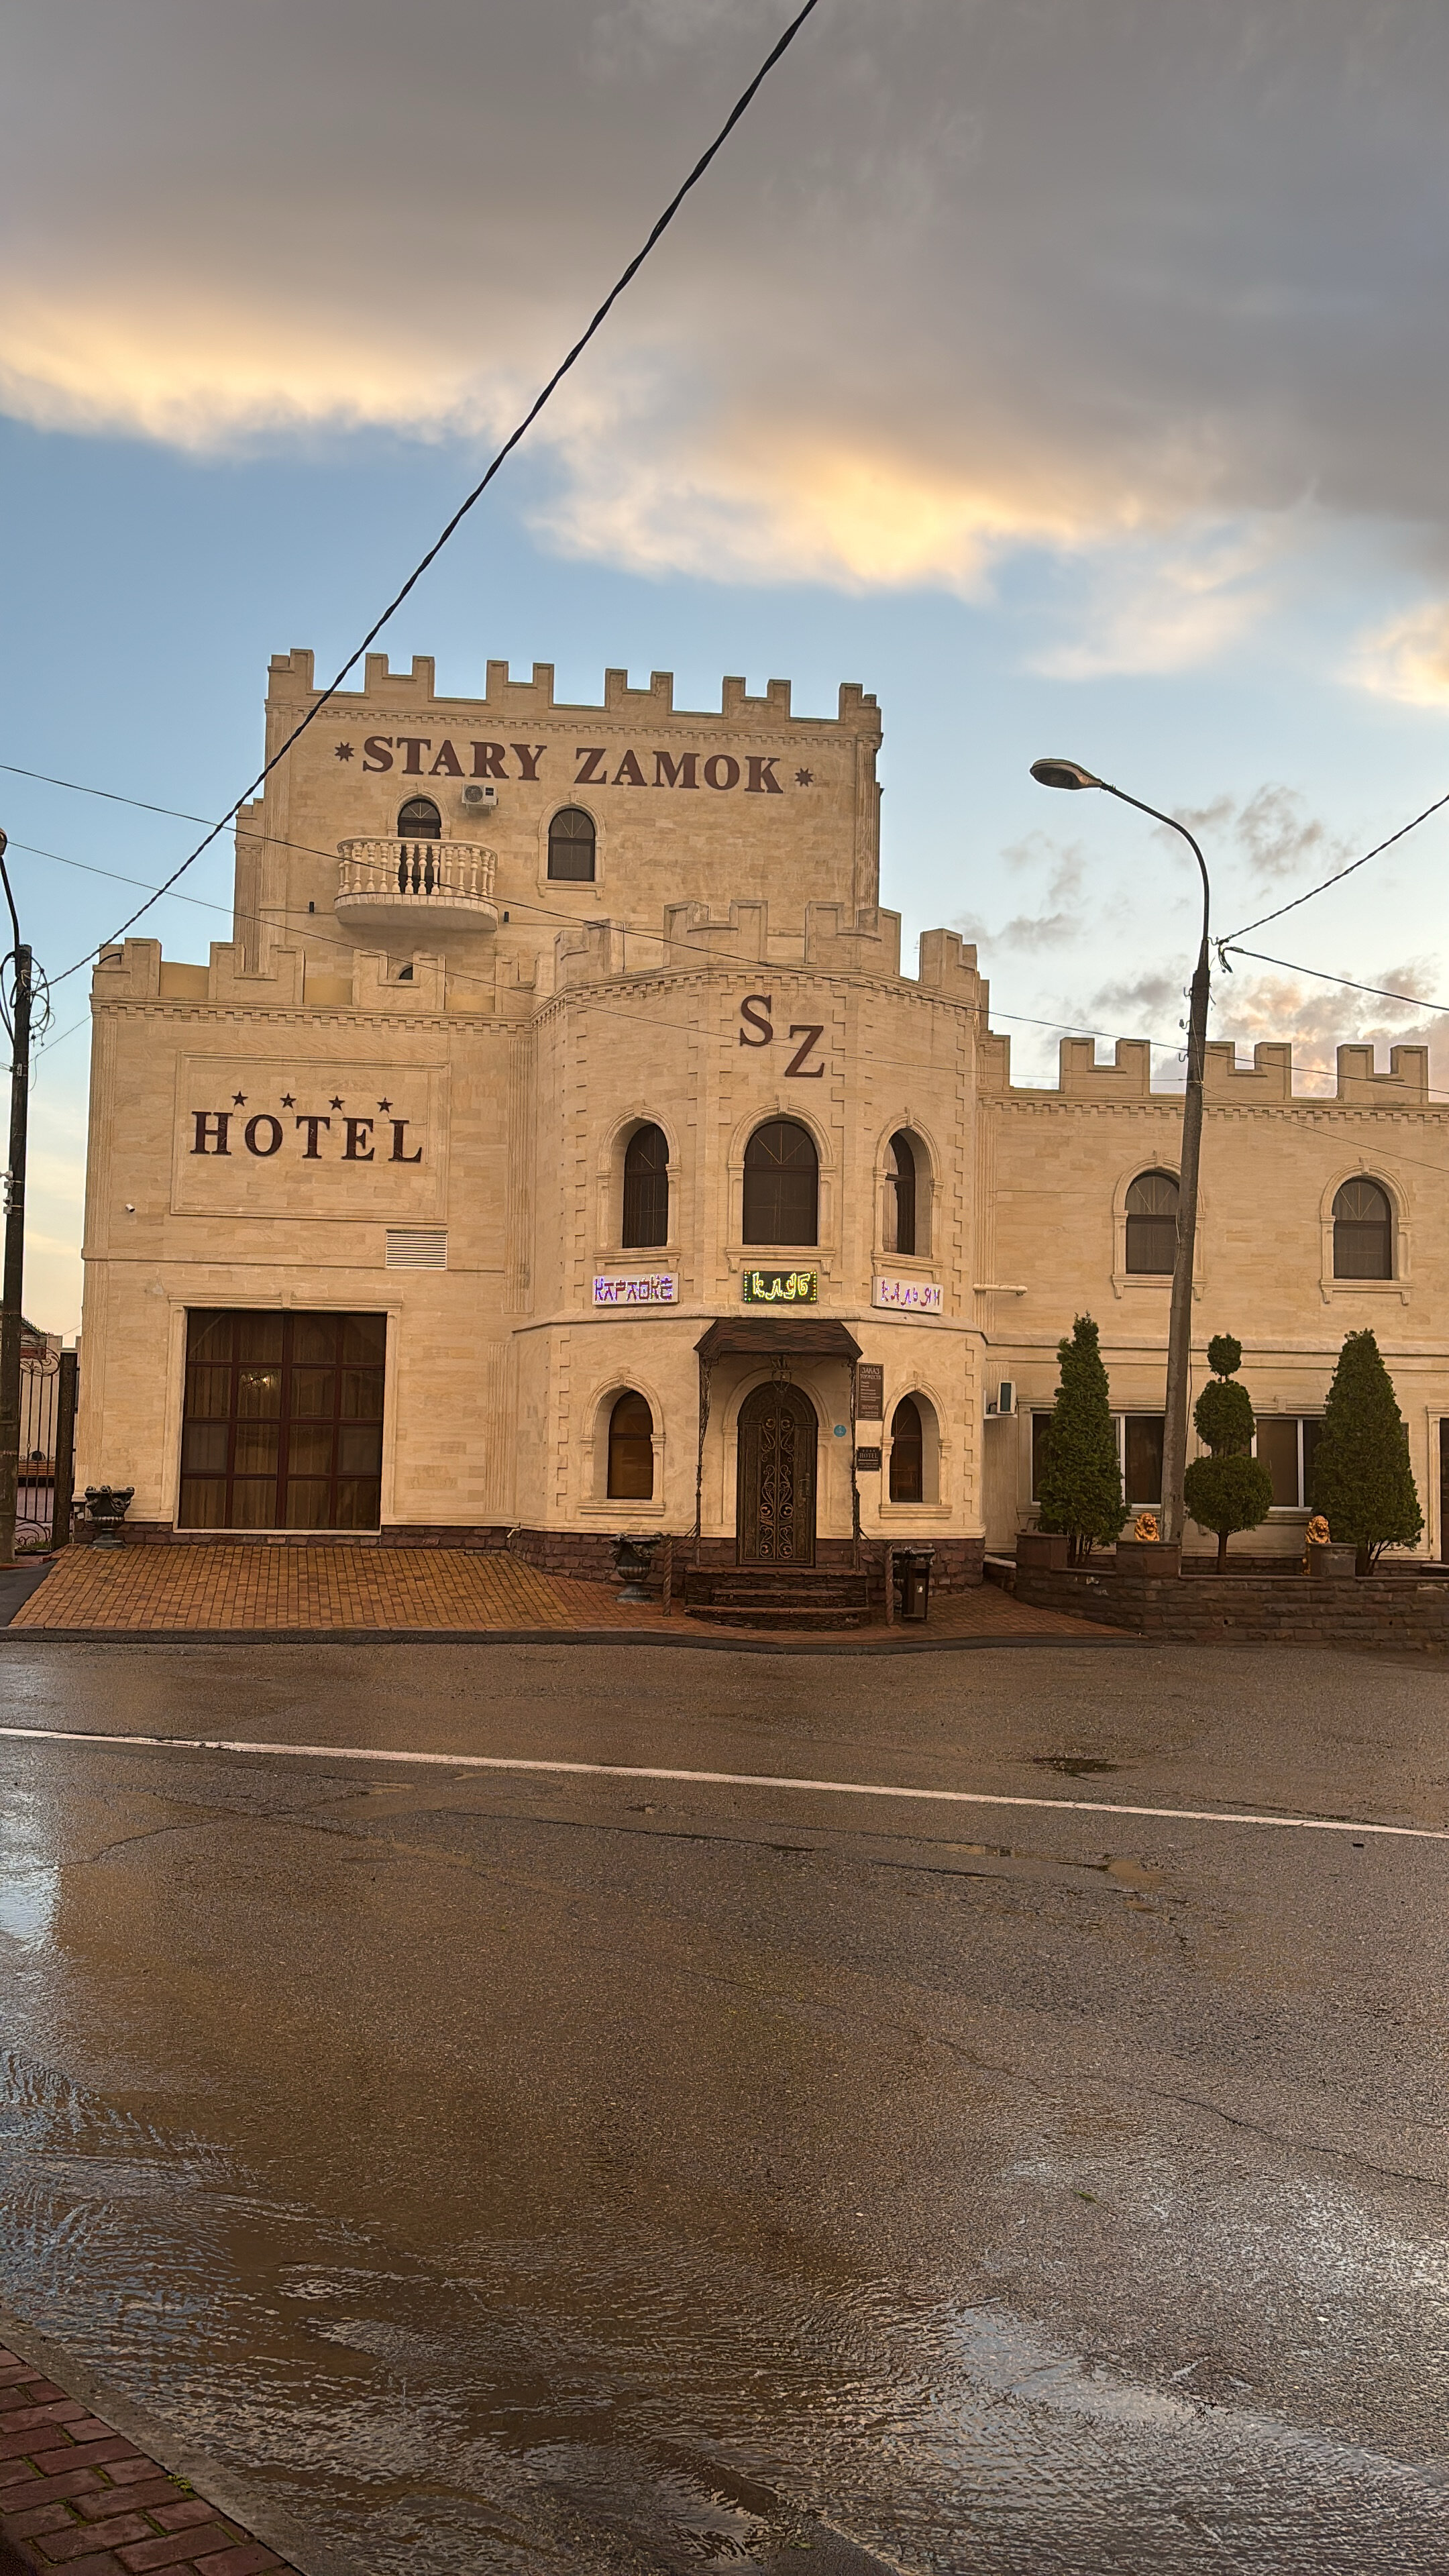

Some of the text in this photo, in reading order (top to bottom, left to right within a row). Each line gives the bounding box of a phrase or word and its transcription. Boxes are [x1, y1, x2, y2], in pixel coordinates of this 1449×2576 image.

[363, 736, 784, 794] STARY ZAMOK
[190, 1111, 423, 1163] HOTEL
[594, 1275, 673, 1302] КАРАОКЕ
